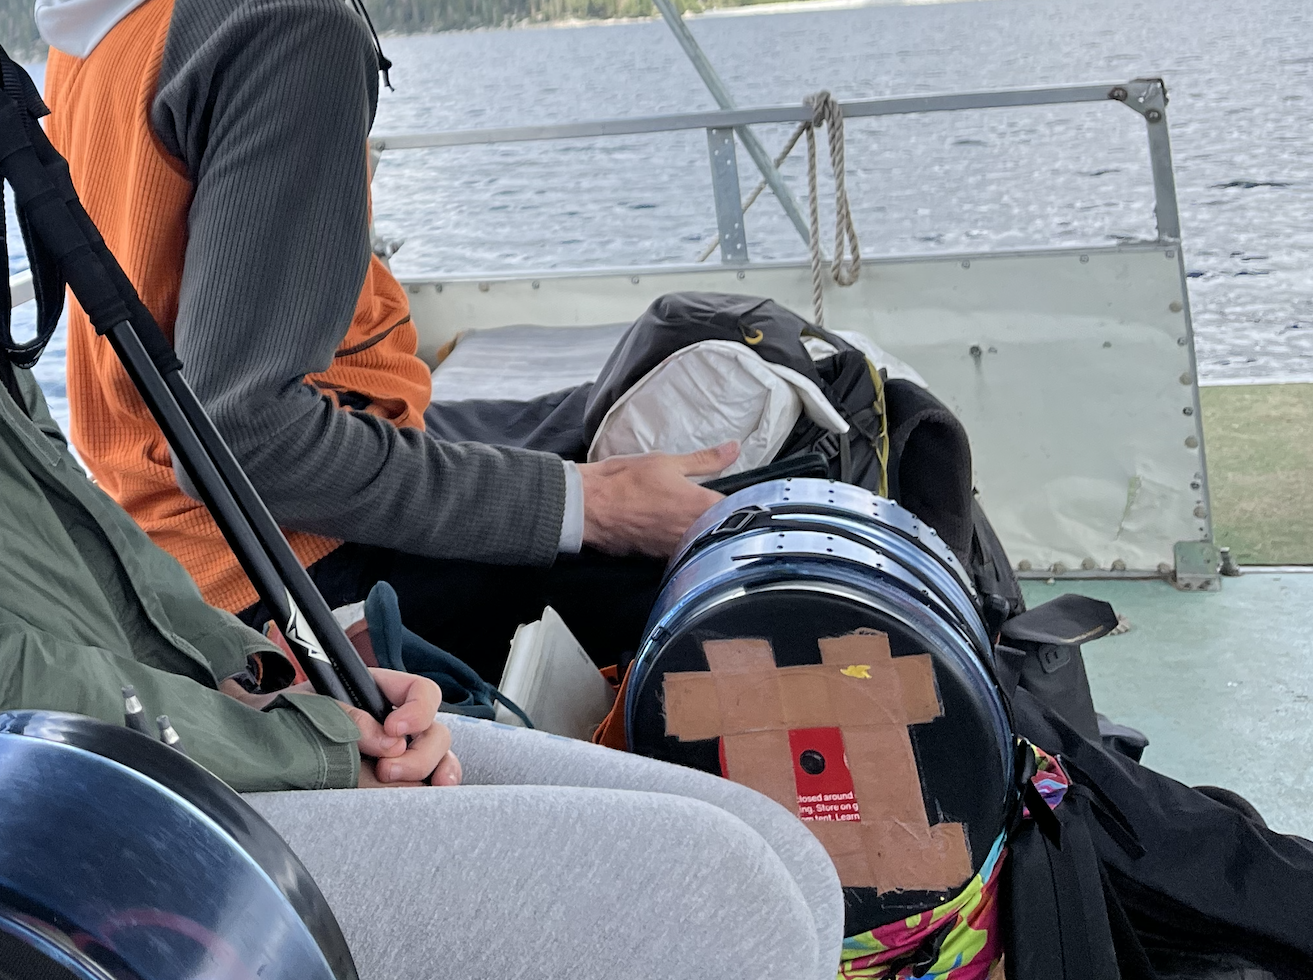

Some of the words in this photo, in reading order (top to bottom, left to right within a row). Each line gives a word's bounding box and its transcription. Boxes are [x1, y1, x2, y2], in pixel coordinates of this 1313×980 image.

[823, 791, 853, 801] around
[816, 803, 839, 812] Store
[840, 802, 852, 811] on
[835, 813, 860, 821] Learn
